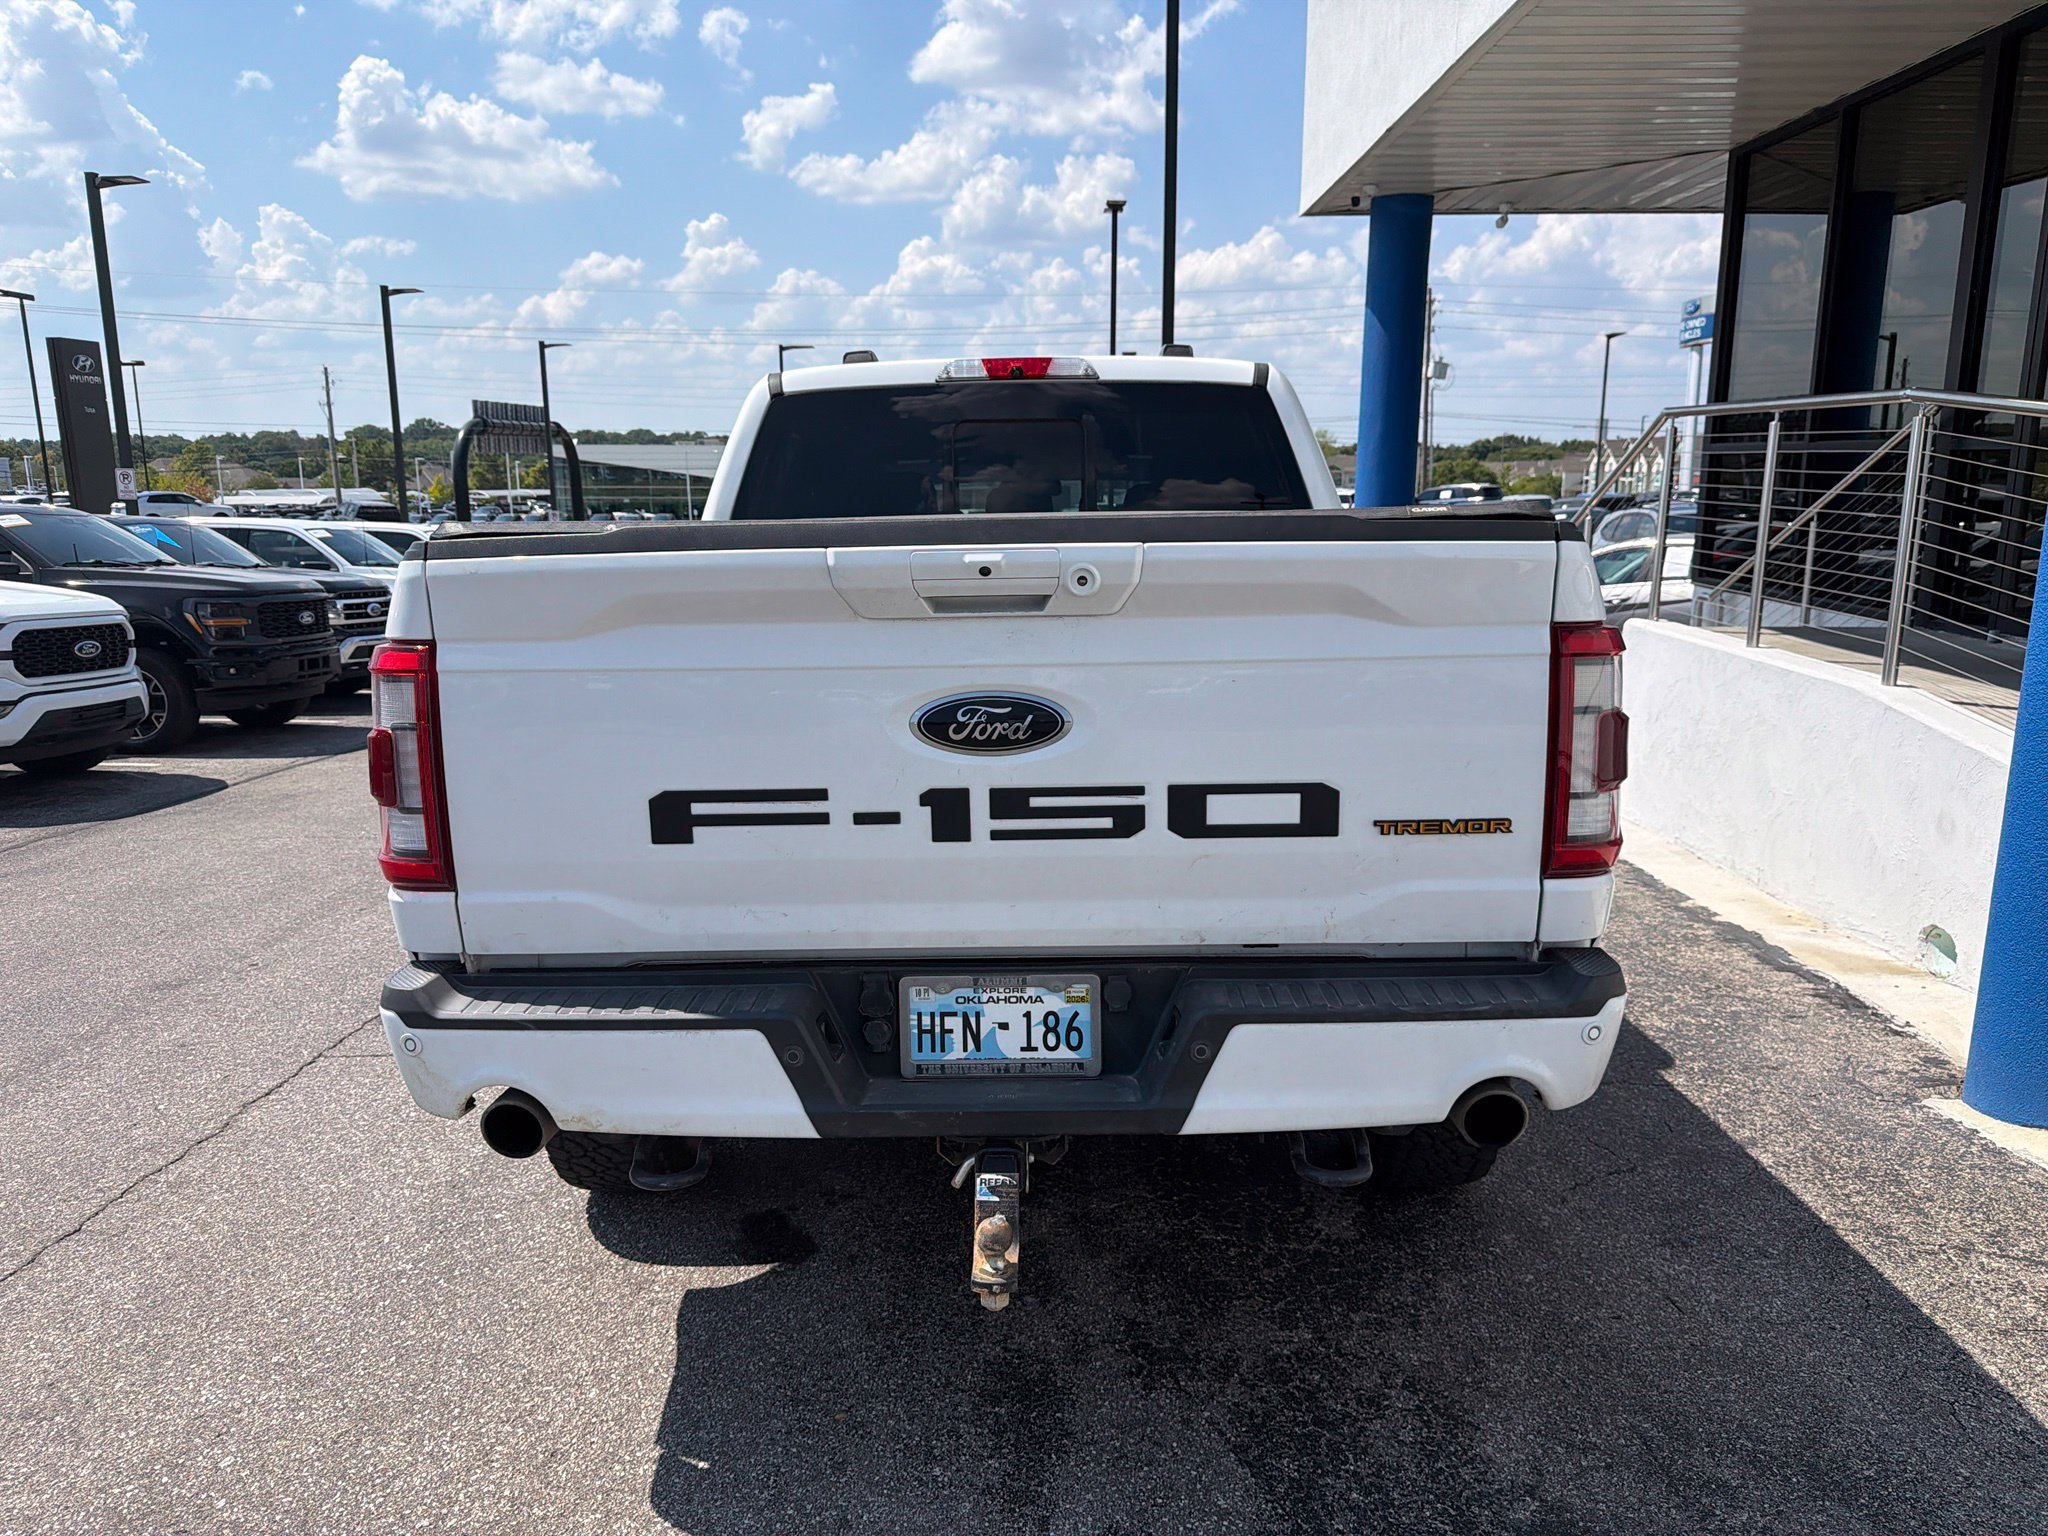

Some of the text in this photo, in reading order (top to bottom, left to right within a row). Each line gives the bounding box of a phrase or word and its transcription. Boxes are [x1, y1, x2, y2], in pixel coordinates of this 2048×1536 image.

[69, 374, 102, 384] HYUNDAI
[948, 705, 1033, 741] Ford
[648, 782, 1341, 845] F-150
[1373, 817, 1514, 836] TREMOR
[976, 977, 1023, 986] ALUMNI
[973, 987, 1027, 995] EXPLORE
[955, 995, 1044, 1005] OKLAHOMA
[1066, 995, 1086, 1004] 2026
[916, 1010, 1084, 1053] HFN 186
[921, 1064, 941, 1074] THE
[944, 1063, 1007, 1074] UNIVERSITY
[1009, 1063, 1022, 1073] OF
